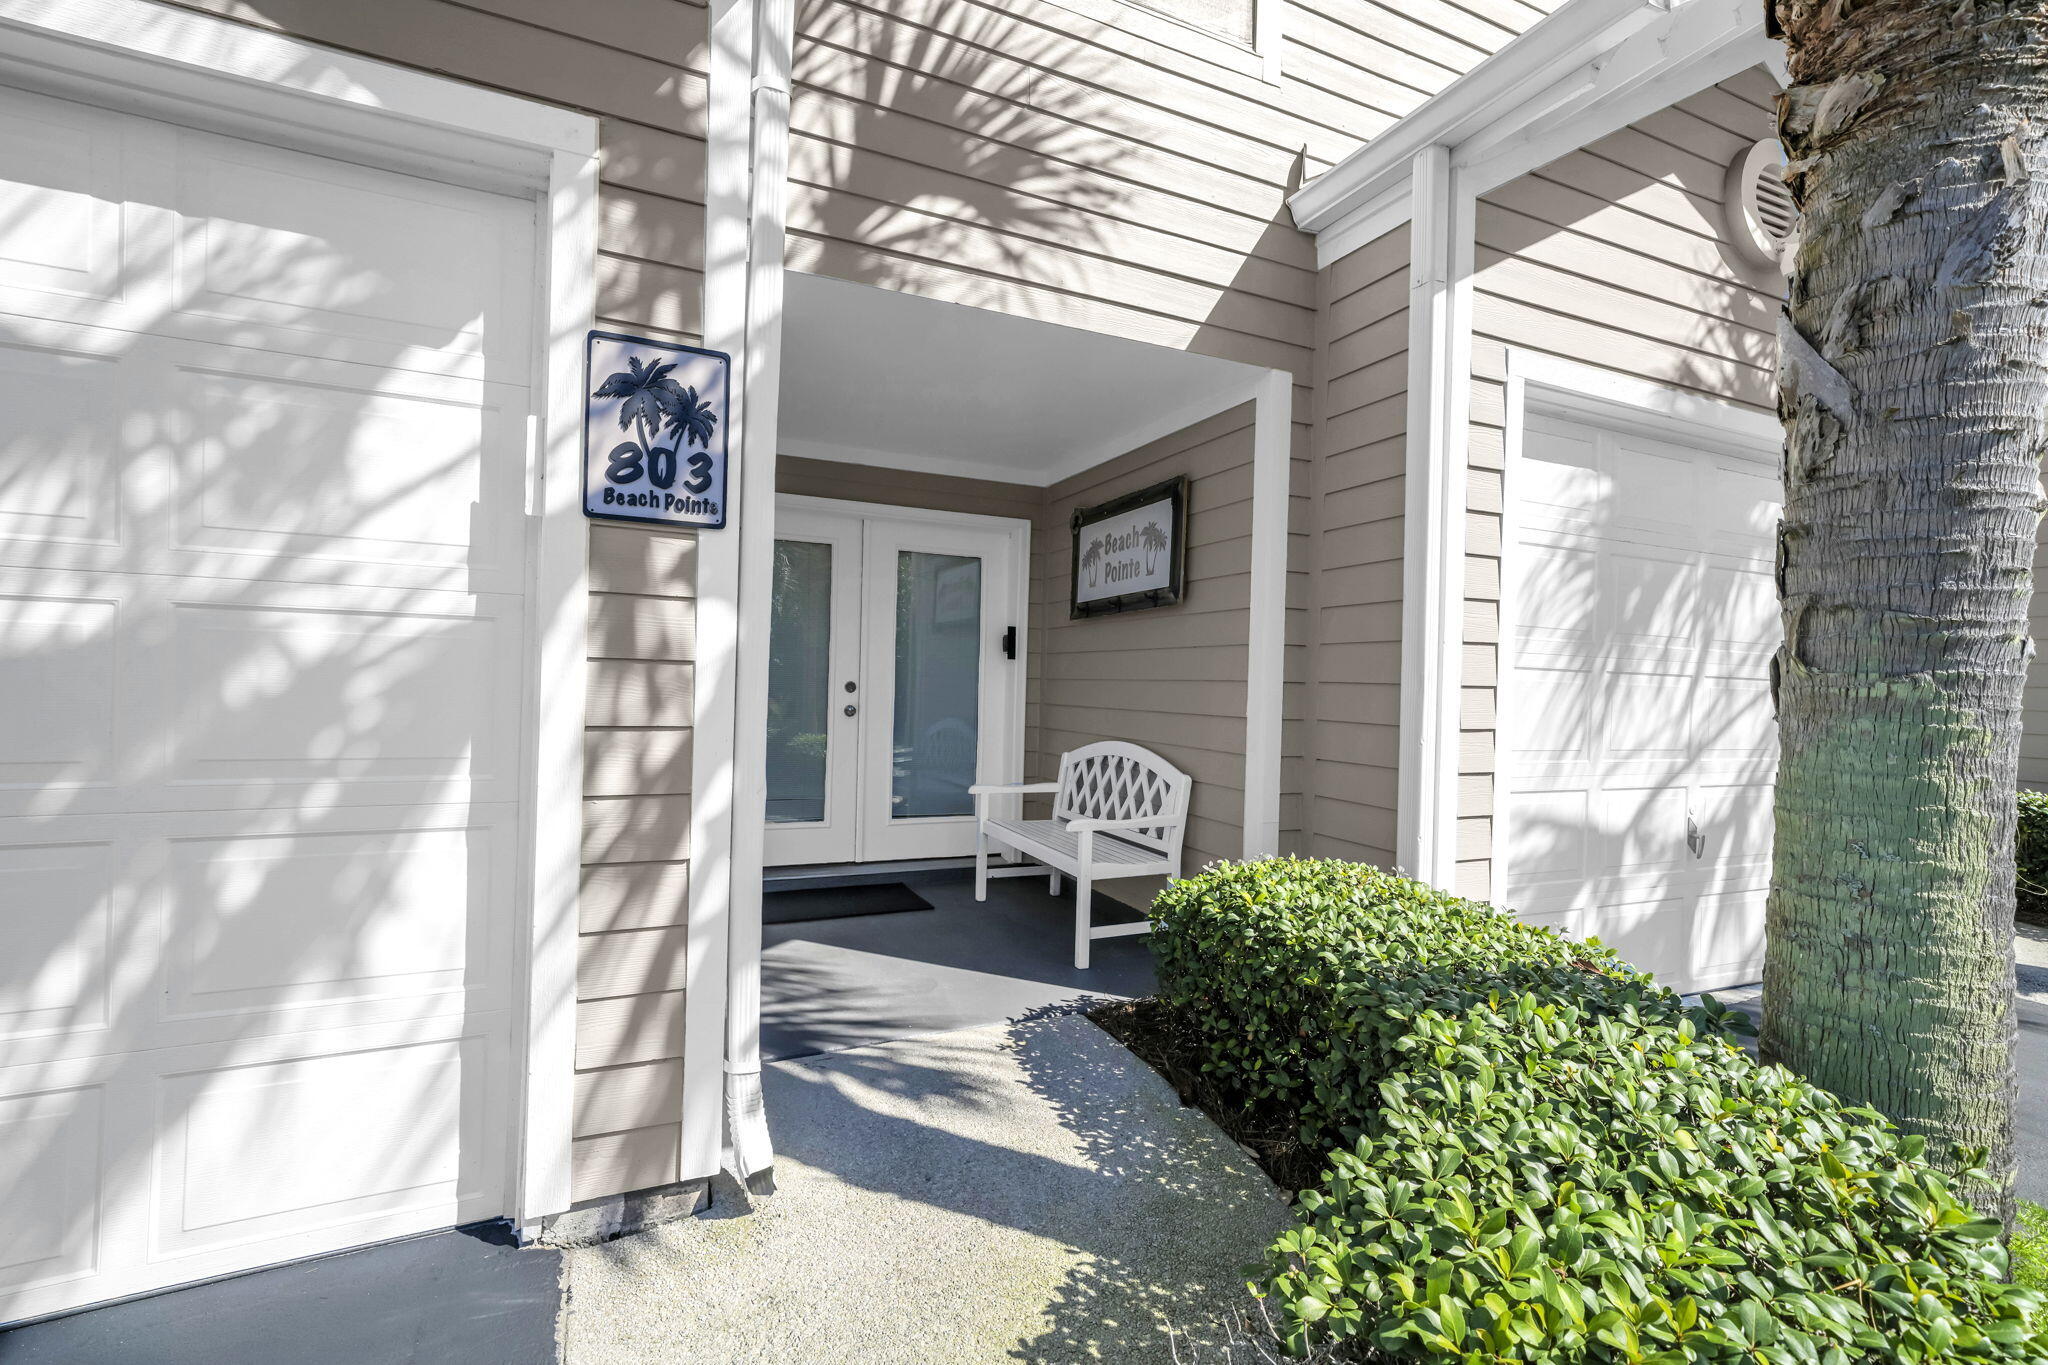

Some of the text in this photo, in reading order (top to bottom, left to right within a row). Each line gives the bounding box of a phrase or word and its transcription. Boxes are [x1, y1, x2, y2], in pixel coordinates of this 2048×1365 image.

[605, 441, 714, 494] 803
[603, 487, 719, 515] Beach Pointe
[1104, 525, 1140, 555] Beach
[1104, 558, 1141, 584] Pointe
